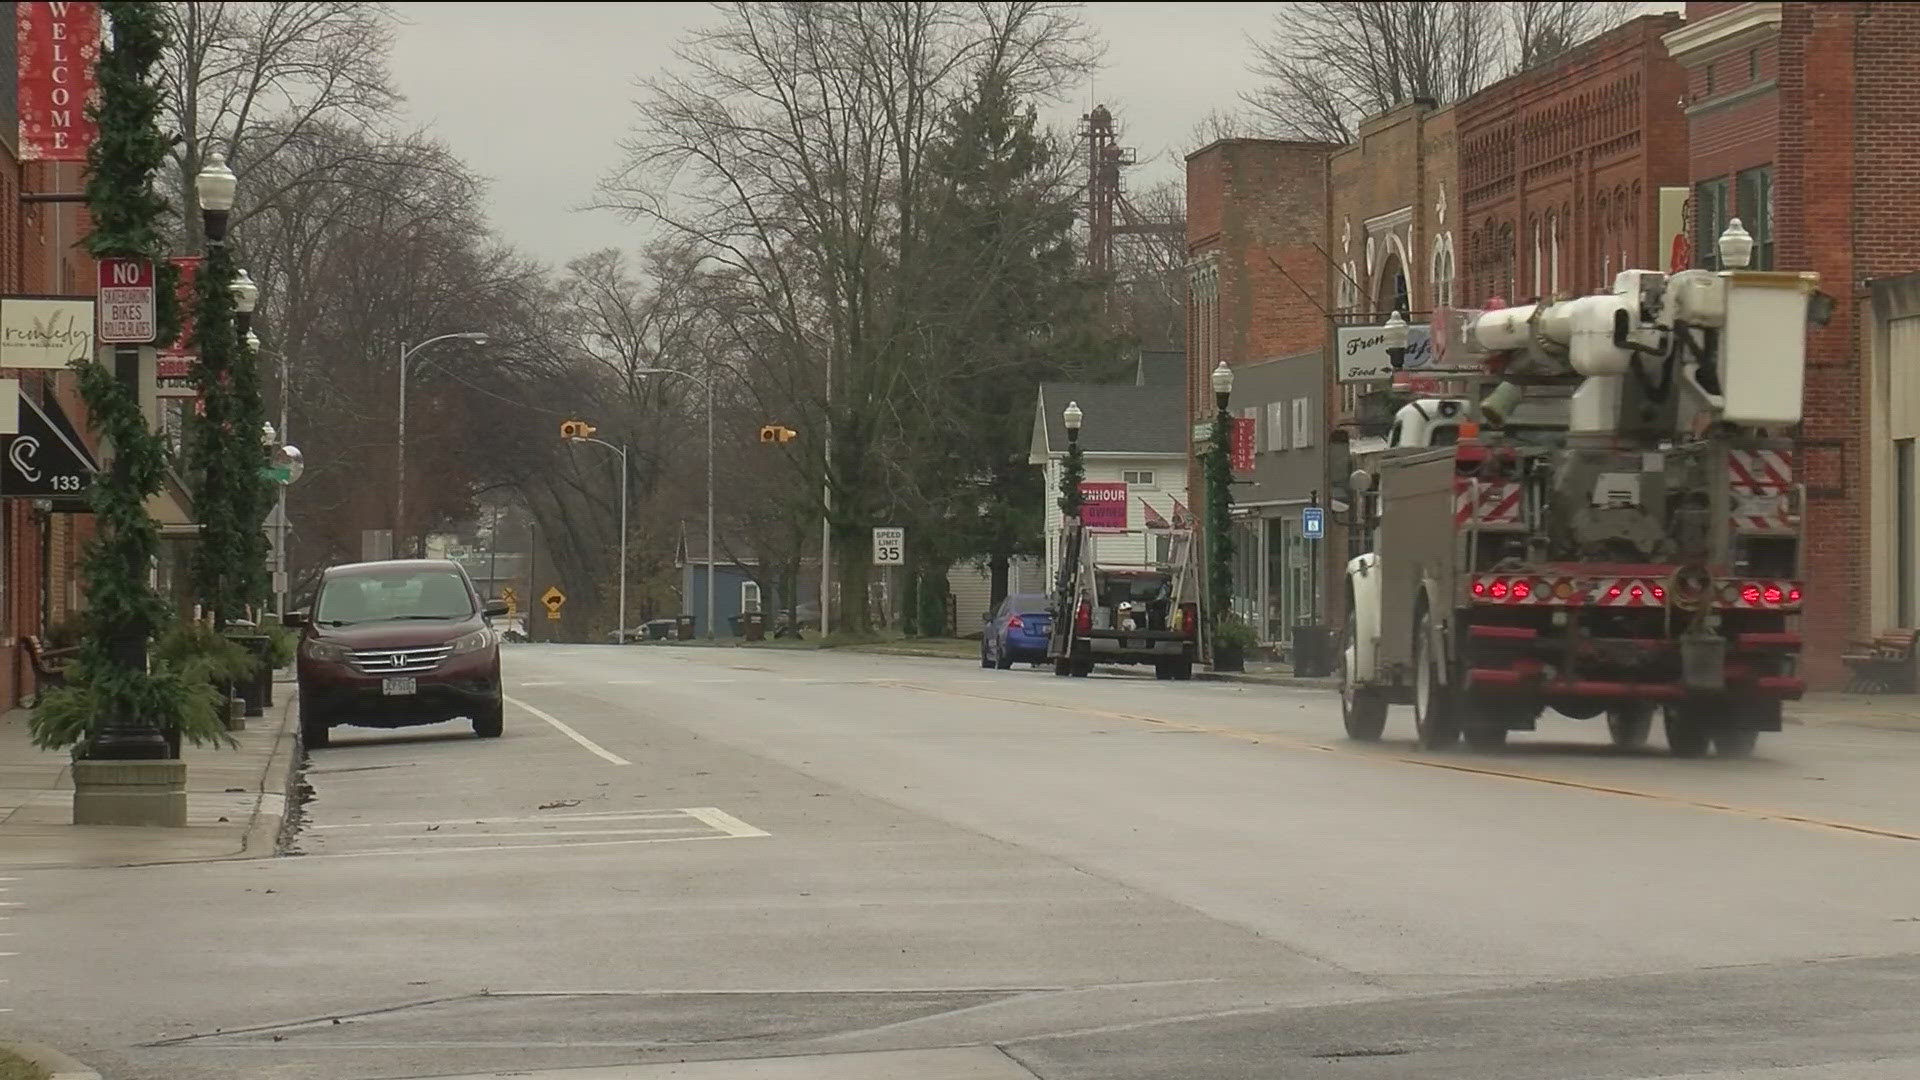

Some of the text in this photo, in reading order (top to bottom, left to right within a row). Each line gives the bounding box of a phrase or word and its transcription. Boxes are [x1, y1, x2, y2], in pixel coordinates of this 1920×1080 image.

[50, 3, 71, 149] WELCOME
[113, 263, 139, 284] NO
[112, 305, 142, 320] BIKES
[6, 315, 91, 361] remedy
[1238, 421, 1246, 468] WELCOME
[50, 475, 80, 490] 133
[878, 547, 900, 561] 35
